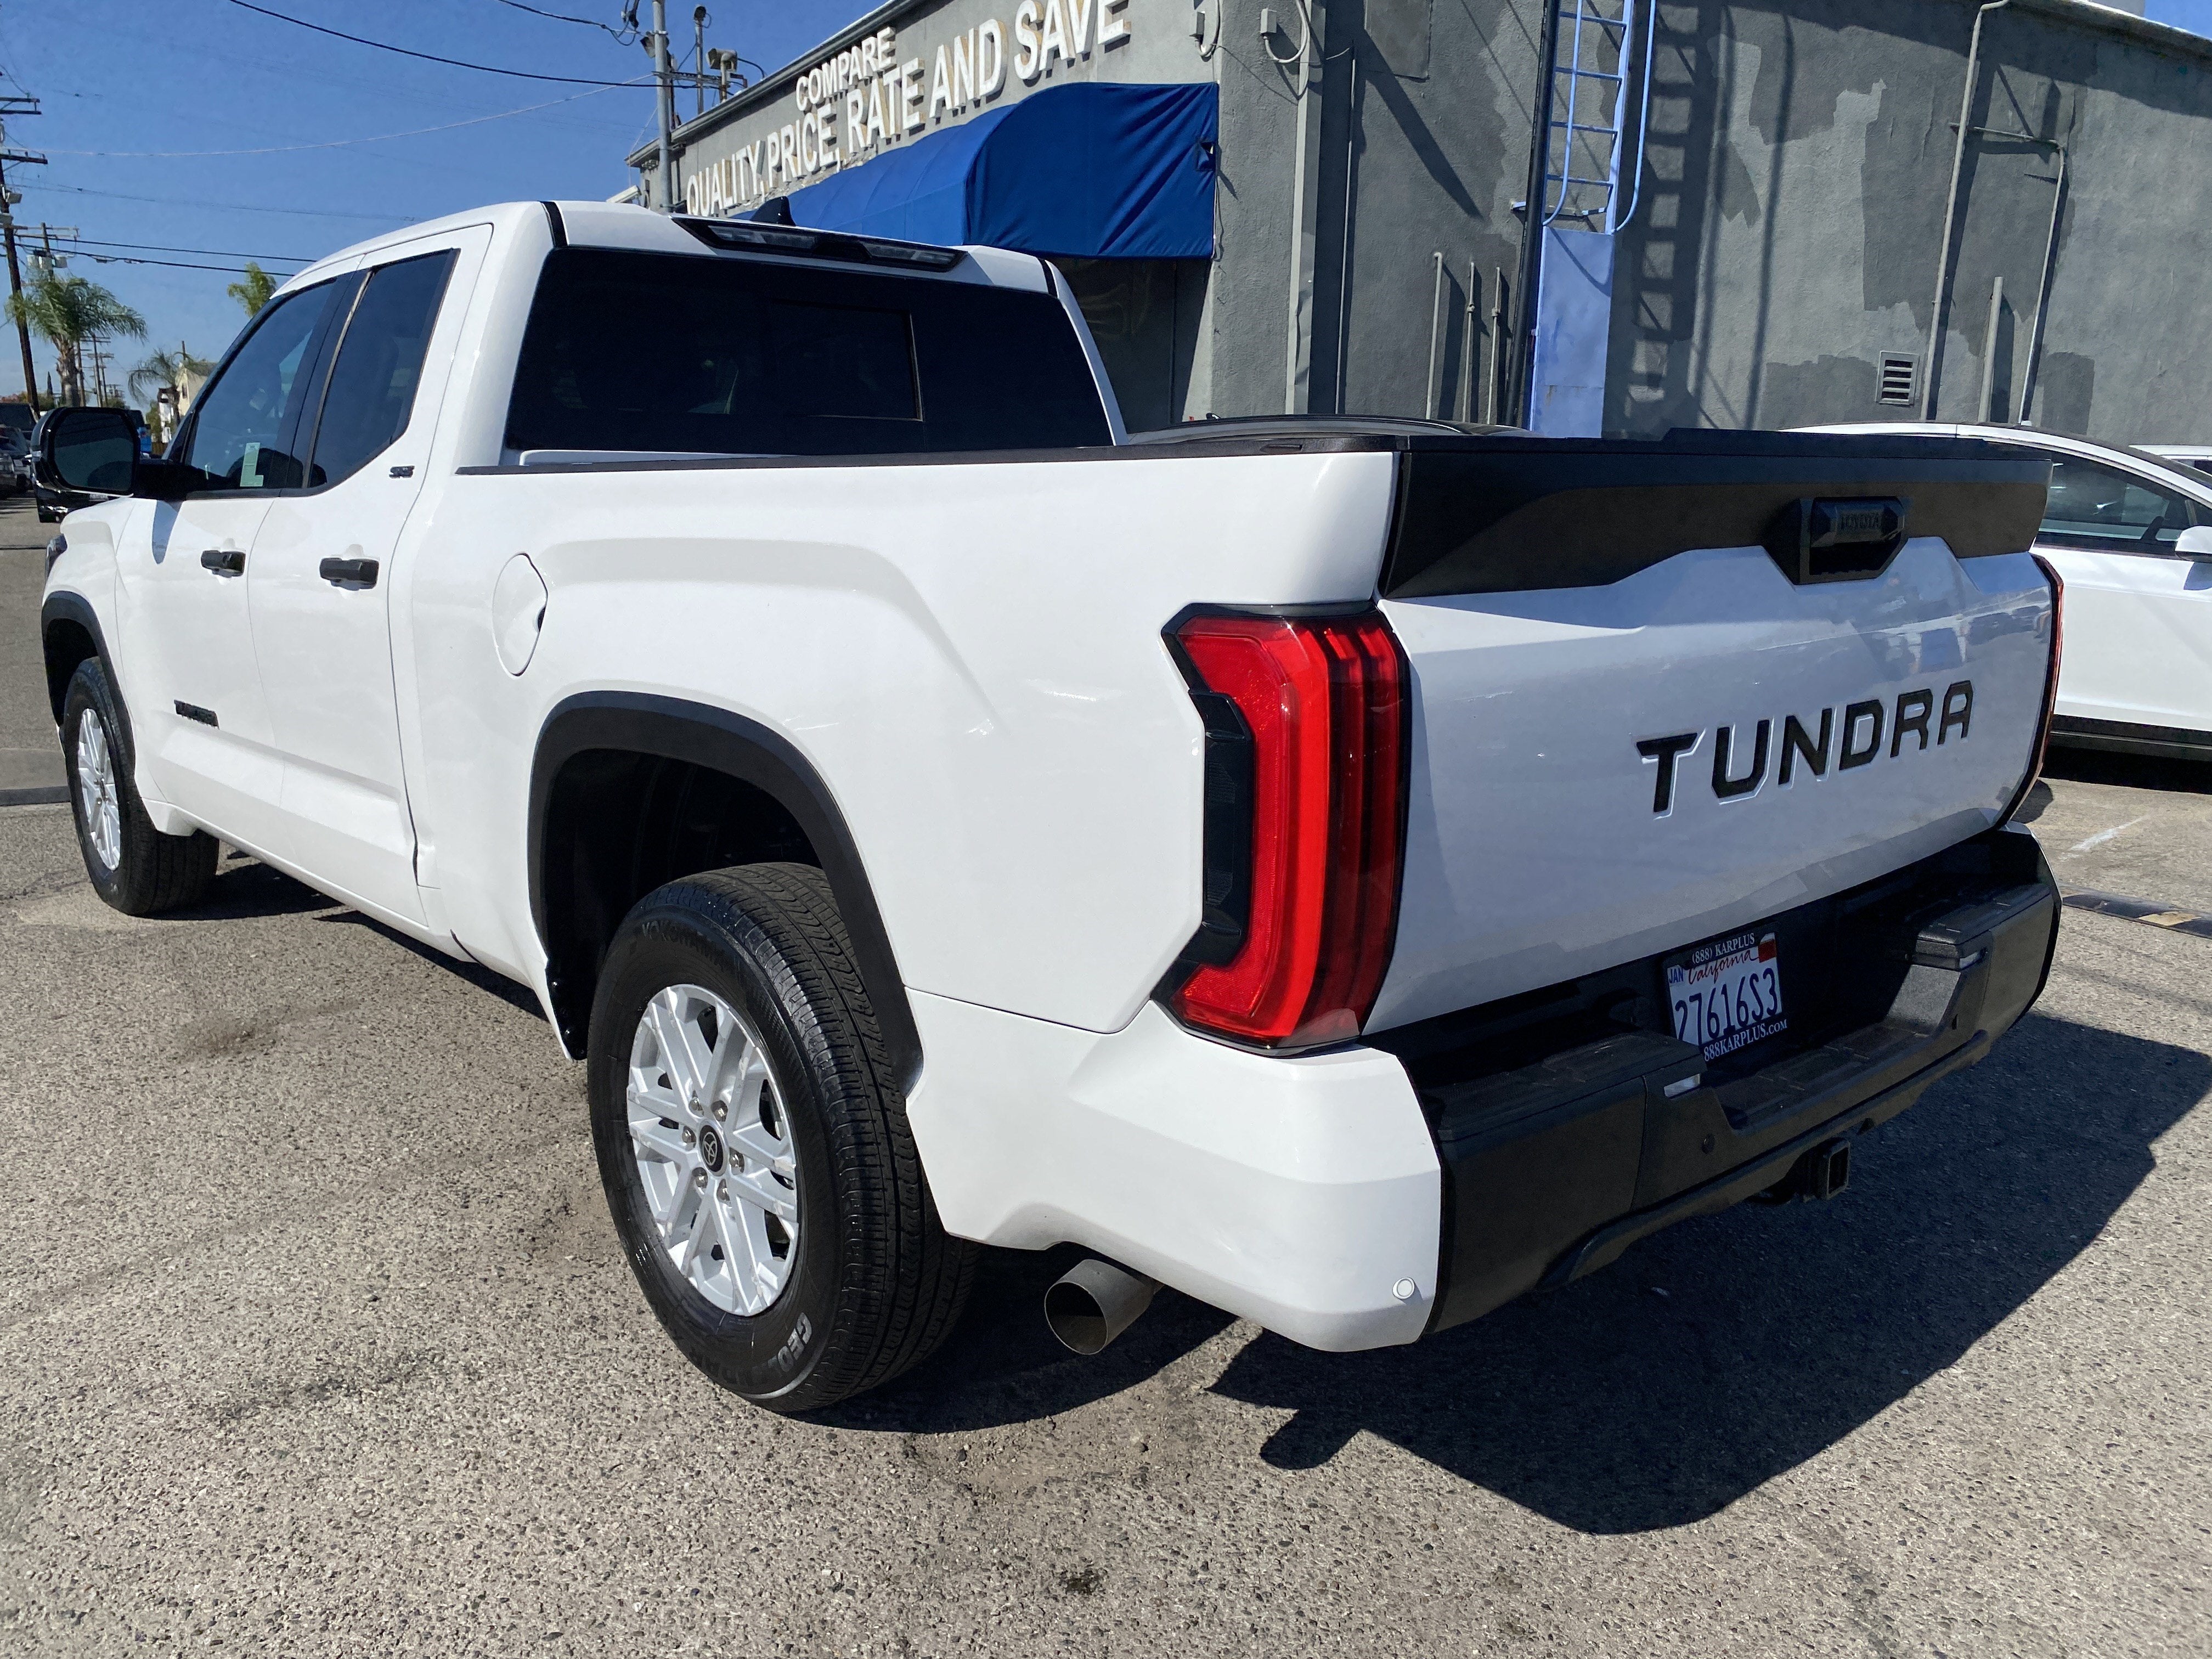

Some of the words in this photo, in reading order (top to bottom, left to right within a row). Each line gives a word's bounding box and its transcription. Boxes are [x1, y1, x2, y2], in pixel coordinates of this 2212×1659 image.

[767, 103, 840, 188] PRICE,
[847, 57, 923, 154] RATE
[929, 18, 1005, 119] AND
[1013, 0, 1128, 80] SAVE
[795, 26, 894, 111] COMPARE
[1636, 680, 1974, 816] TUNDRA
[1669, 968, 1684, 984] JAN
[1688, 949, 1759, 985] California
[1692, 948, 1713, 964] (888)
[1715, 933, 1755, 957] KARPLUS
[1675, 968, 1778, 1046] 27616S3
